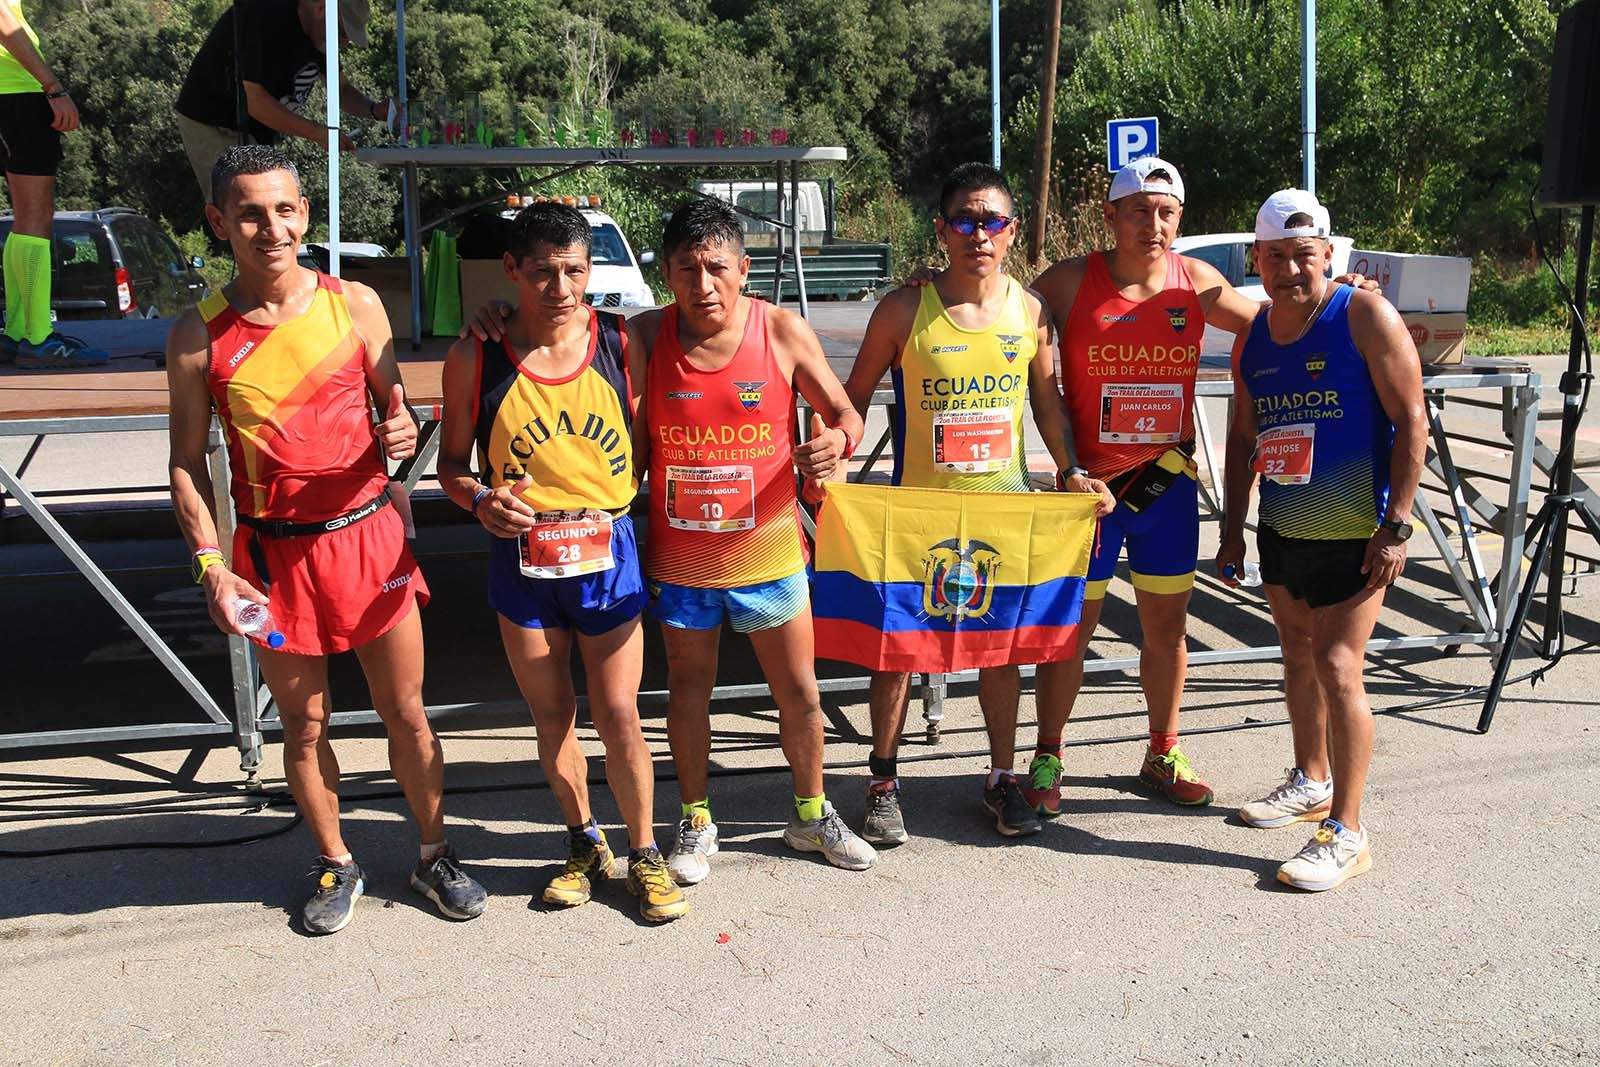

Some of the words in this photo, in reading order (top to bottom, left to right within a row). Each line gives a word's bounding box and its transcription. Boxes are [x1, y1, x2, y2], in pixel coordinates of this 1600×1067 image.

[1118, 125, 1148, 166] P
[1088, 344, 1198, 364] ECUADOR
[1087, 366, 1116, 376] CLUB
[1120, 365, 1135, 376] DE
[1138, 366, 1196, 376] ATLETISMO
[922, 374, 1021, 397] ECUADOR
[920, 400, 949, 411] CLUB
[951, 399, 967, 409] DE
[970, 396, 1018, 408] ATLETIS
[1120, 404, 1141, 412] JUAN
[1142, 403, 1172, 411] CARLOS
[1134, 416, 1157, 432] 42
[1280, 409, 1344, 423] ATLETISMO
[659, 423, 771, 445] ECUADOR
[503, 410, 627, 481] ECUADOR
[661, 447, 685, 460] CLUB
[688, 449, 703, 460] DE
[707, 445, 775, 461] ATLETISMO
[970, 443, 991, 459] 15
[1279, 443, 1300, 456] JOSE
[1264, 459, 1286, 474] 32
[713, 487, 740, 495] MIGUEL
[349, 503, 378, 522] Kalenji
[699, 503, 724, 519] 10
[537, 527, 598, 541] SEGUNDO
[556, 544, 581, 562] 28
